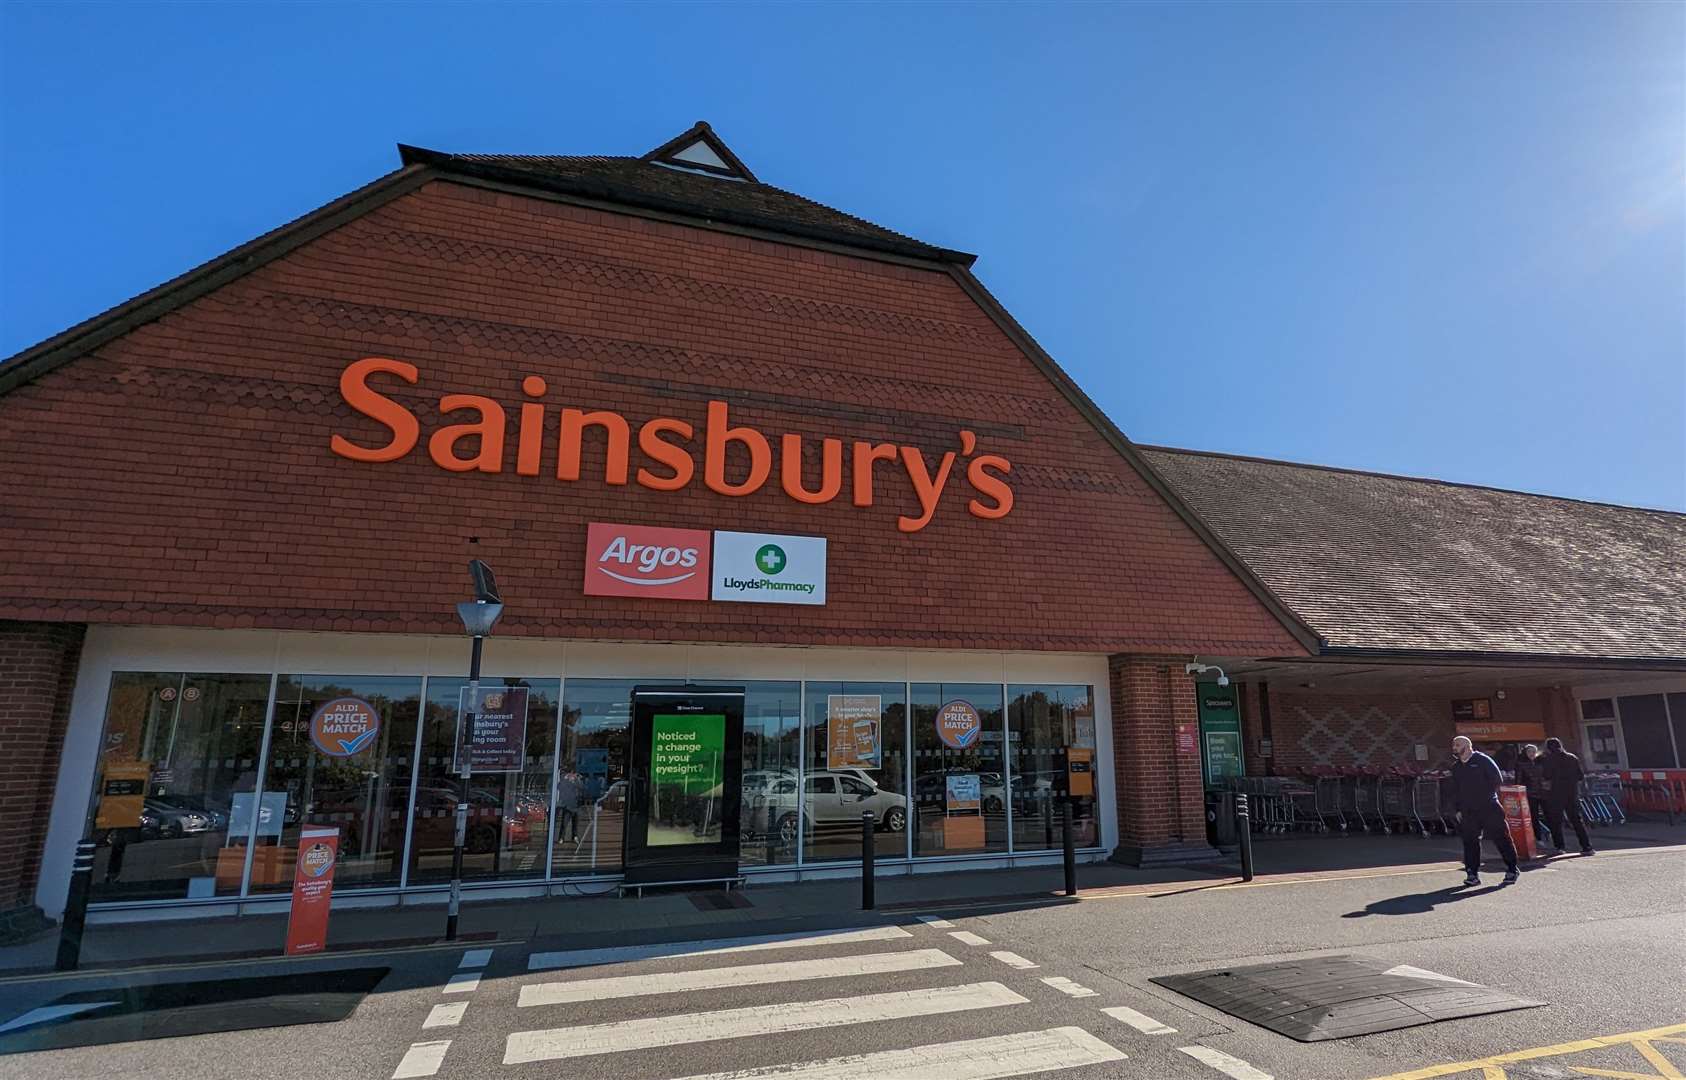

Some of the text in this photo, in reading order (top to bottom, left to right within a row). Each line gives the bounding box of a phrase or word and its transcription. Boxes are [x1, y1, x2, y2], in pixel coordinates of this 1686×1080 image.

[330, 357, 1014, 532] Sainsbury's
[599, 536, 698, 573] Argos
[723, 577, 815, 594] LloydsPharmacy
[335, 704, 358, 712] ALDI
[323, 712, 368, 724] PRICE
[943, 712, 973, 722] PRICE
[322, 723, 367, 734] MATCH
[943, 721, 973, 730] MATCH
[657, 731, 696, 741] Noticed
[665, 743, 702, 753] change
[656, 753, 690, 763] in your
[656, 763, 704, 775] eyesight?
[306, 851, 329, 859] PRICE
